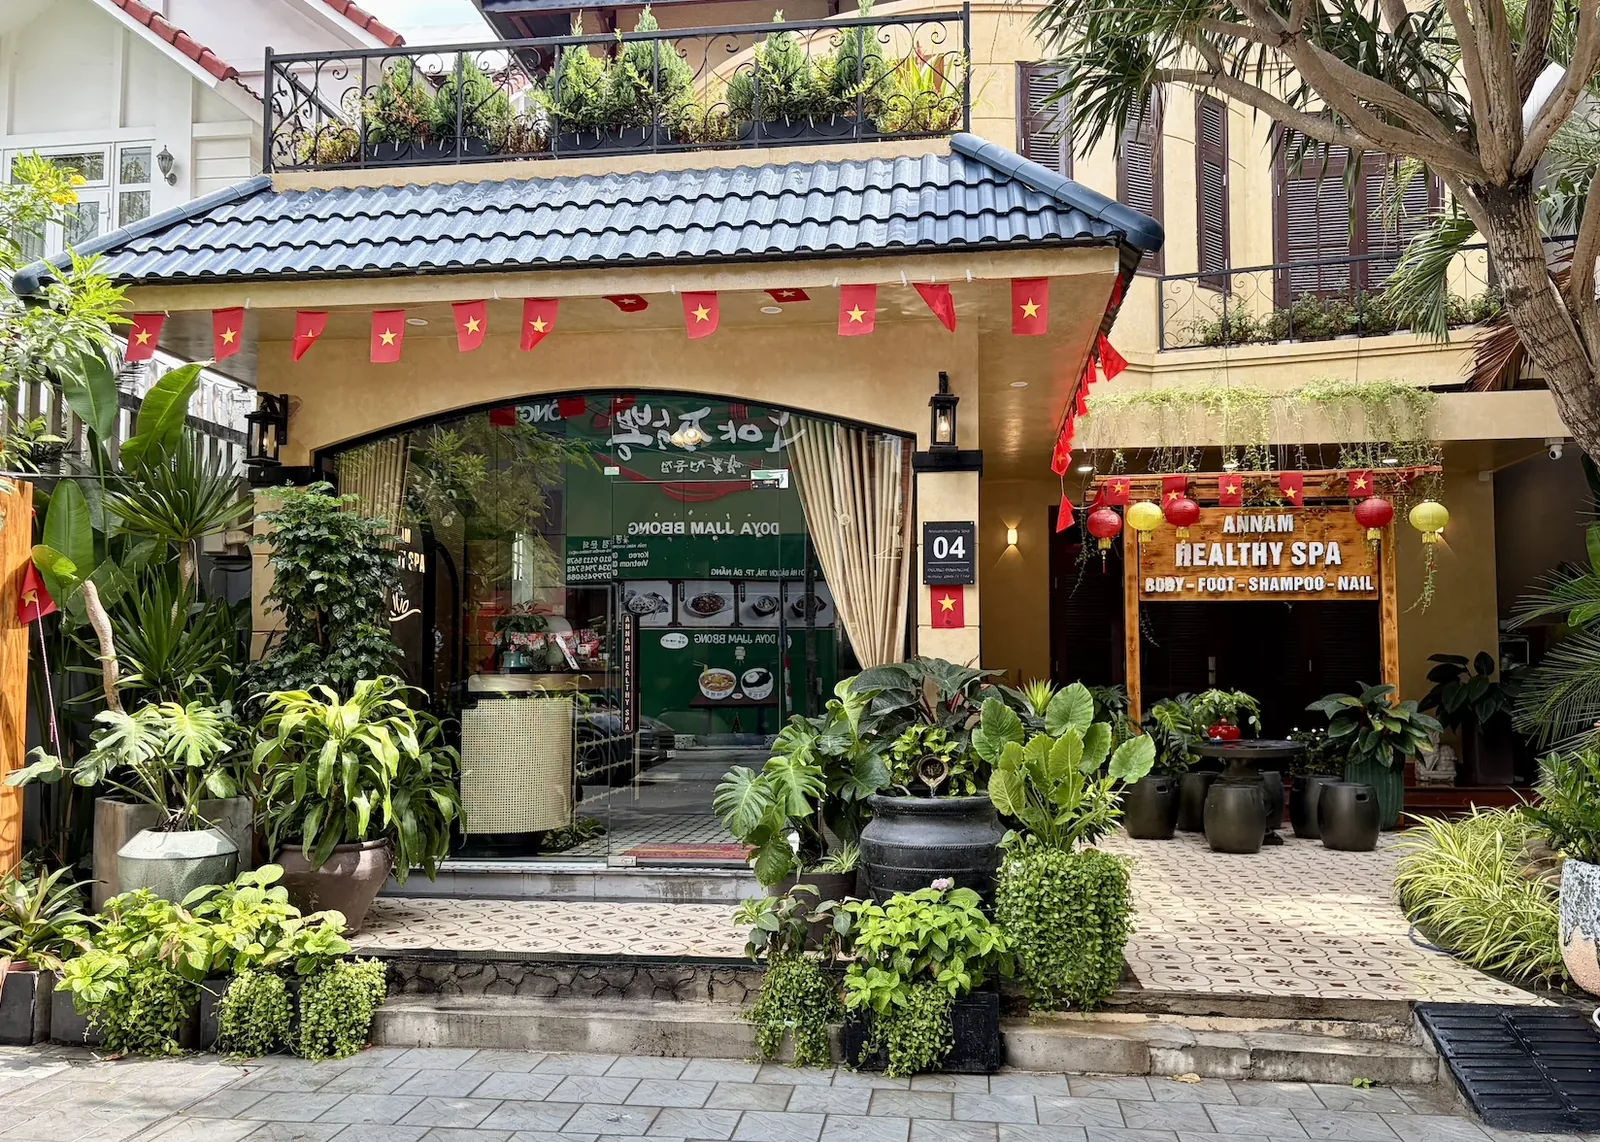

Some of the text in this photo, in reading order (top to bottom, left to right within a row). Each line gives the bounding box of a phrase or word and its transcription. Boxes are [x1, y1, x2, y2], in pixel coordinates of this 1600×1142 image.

[1223, 514, 1294, 533] ANNAM
[933, 536, 966, 559] 04
[1175, 541, 1342, 567] HEALTHY SPA
[1145, 576, 1186, 593] BODY
[1197, 577, 1235, 592] FOOT
[1248, 576, 1324, 592] SHAMPOO
[1337, 576, 1374, 591] NAIL
